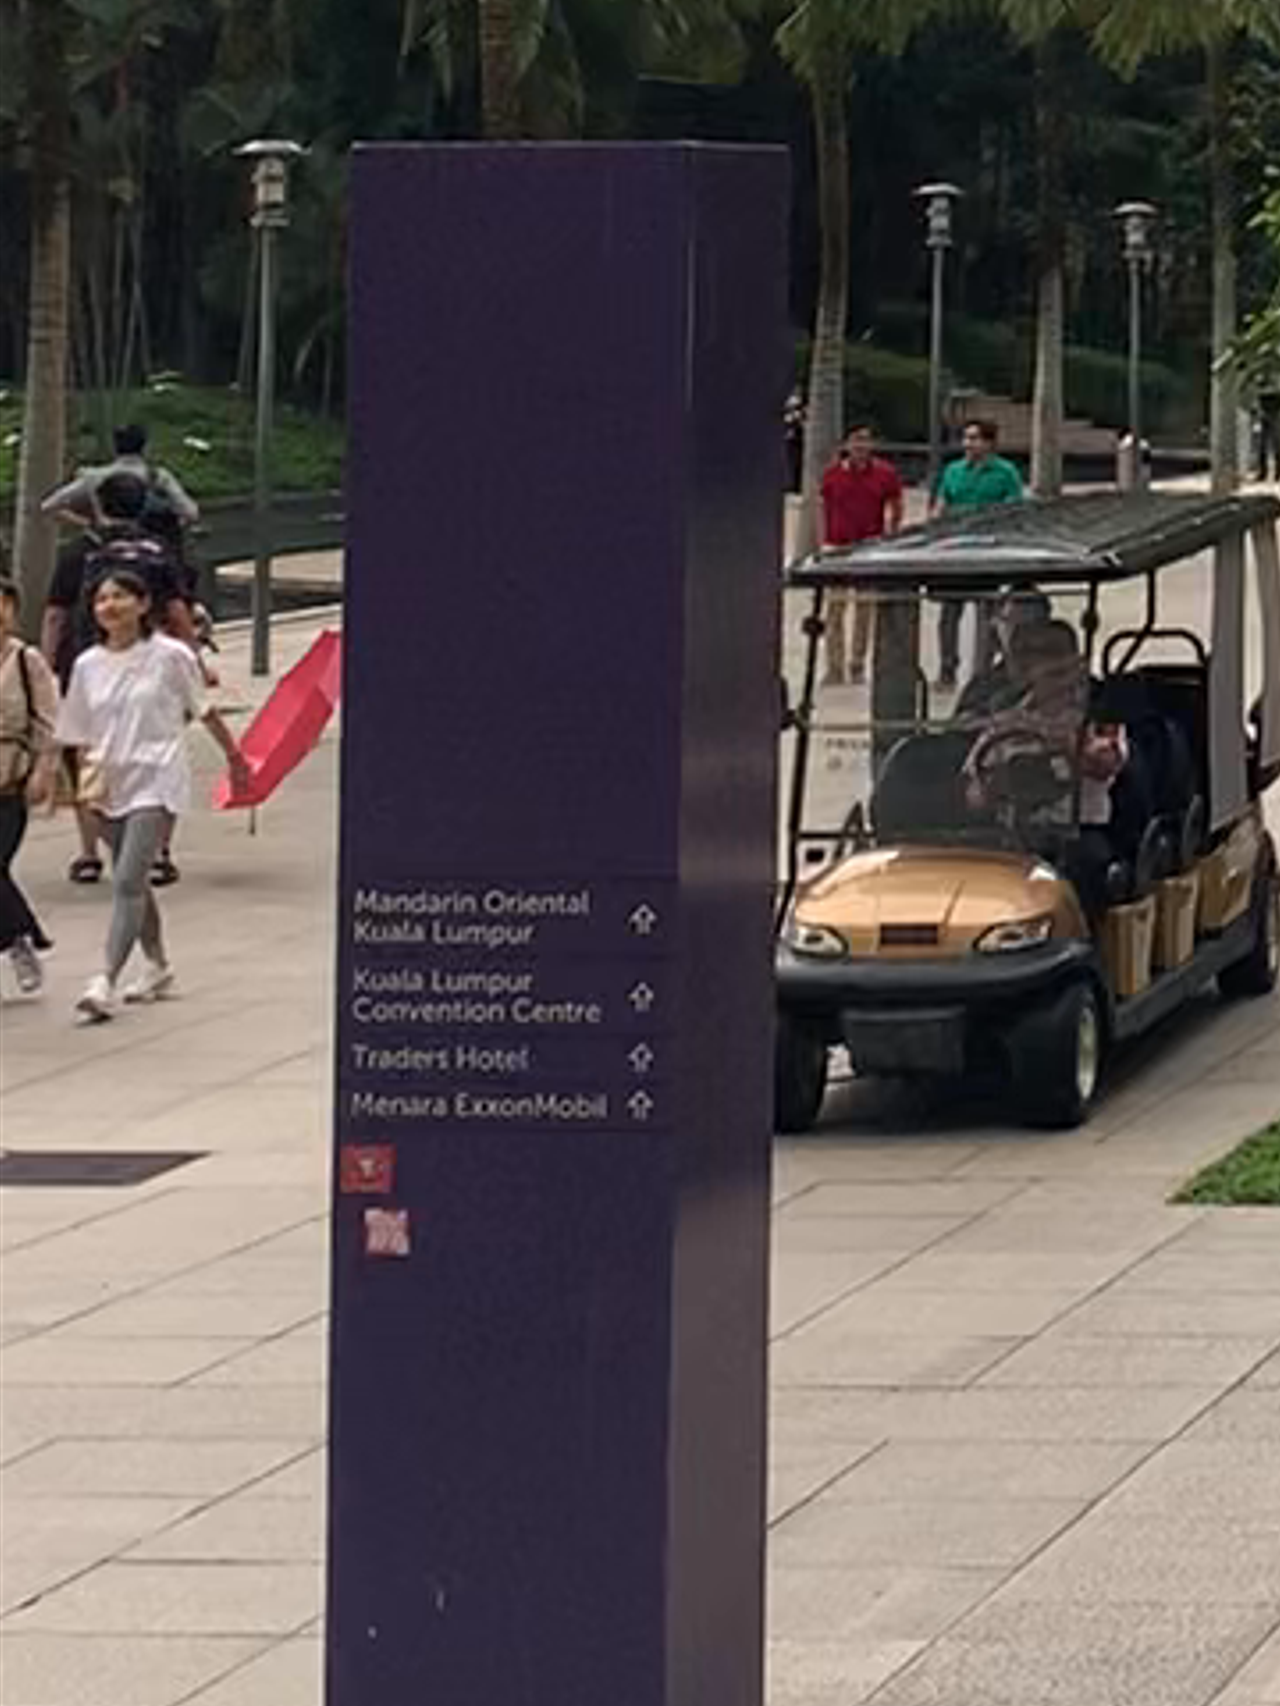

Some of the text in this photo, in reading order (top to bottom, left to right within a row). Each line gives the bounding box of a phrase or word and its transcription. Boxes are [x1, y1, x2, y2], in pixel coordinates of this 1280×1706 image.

[354, 890, 590, 914] Mandarin Oriental
[354, 920, 534, 948] Kuala Lumpur
[354, 968, 533, 998] Kuala Lumpur
[352, 997, 602, 1023] Convention Centre
[352, 1043, 529, 1071] Traders Hotel
[351, 1093, 608, 1118] Menara ExxonMobil
